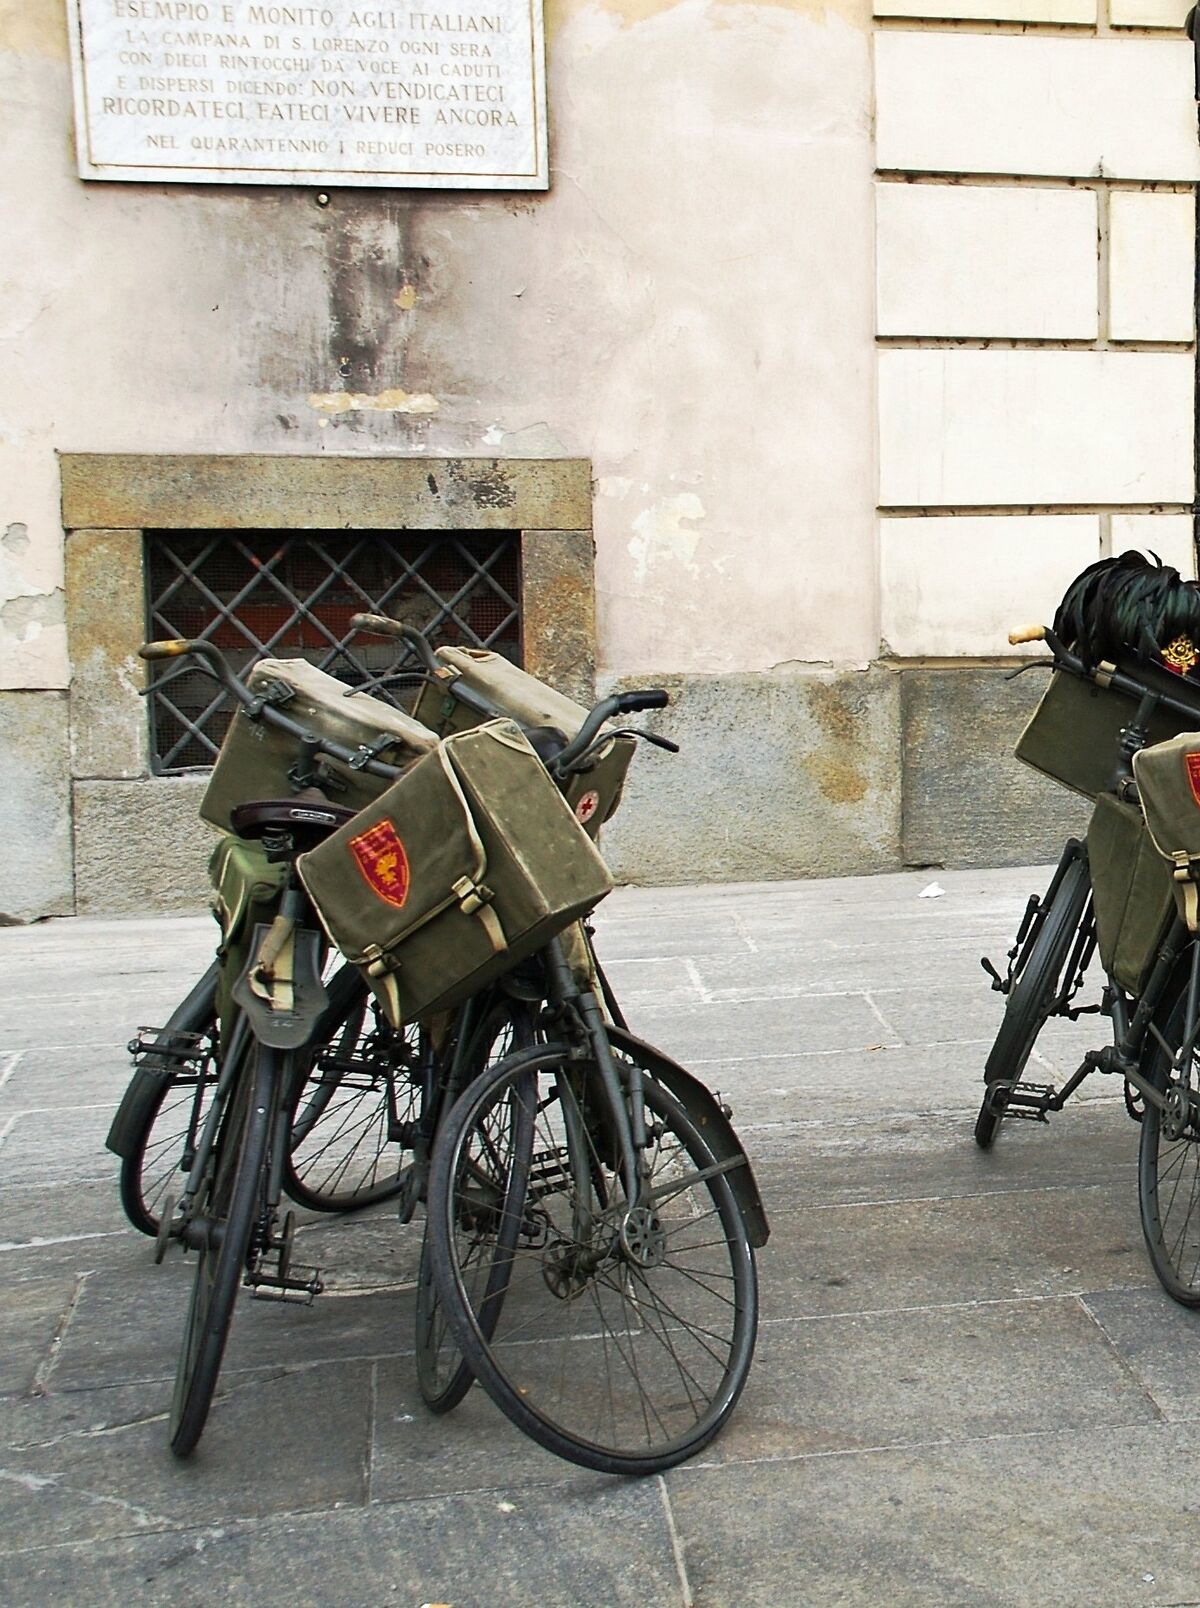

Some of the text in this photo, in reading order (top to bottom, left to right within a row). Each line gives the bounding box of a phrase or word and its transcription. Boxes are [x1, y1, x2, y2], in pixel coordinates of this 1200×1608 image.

[114, 0, 502, 34] ESEMPIO E MONITO AGLI ITALIANI
[126, 29, 150, 45] LA
[162, 31, 251, 49] CAMPANA
[264, 35, 280, 50] DI
[312, 37, 390, 54] LORENZO
[400, 40, 440, 56] OGNI
[450, 42, 492, 58] SERA
[119, 51, 152, 66] CON
[164, 53, 208, 69] DIECI
[220, 55, 310, 72] RINTOCCHI
[358, 60, 401, 76] VOCE
[412, 62, 430, 77] AI
[440, 63, 501, 79] CADUTI
[117, 75, 128, 91] E
[139, 76, 215, 94] DISPERSI
[311, 79, 355, 98] NON
[369, 80, 505, 103] VENDICATECI
[258, 101, 330, 122] FATECI
[342, 104, 421, 125] VIVERE
[434, 107, 519, 128] ANCORA
[147, 134, 179, 150] NEL
[191, 136, 329, 155] QUARANTENNIO
[356, 140, 414, 156] REDUCI
[425, 142, 486, 158] POSERO
